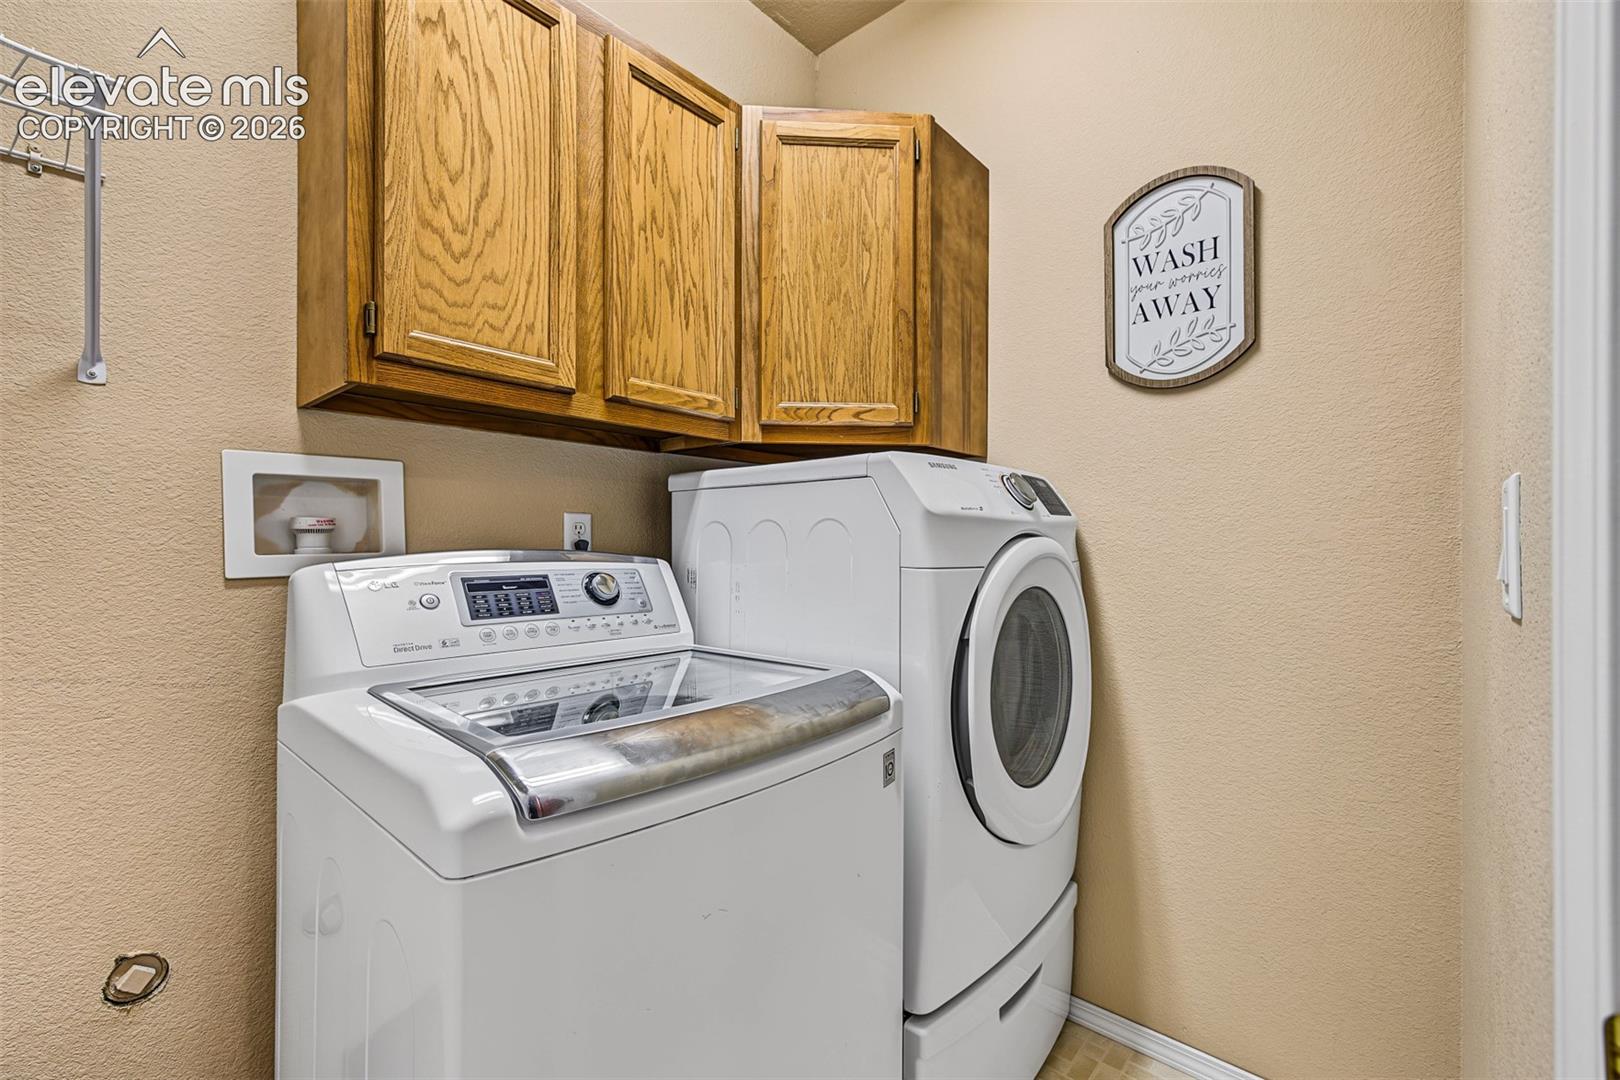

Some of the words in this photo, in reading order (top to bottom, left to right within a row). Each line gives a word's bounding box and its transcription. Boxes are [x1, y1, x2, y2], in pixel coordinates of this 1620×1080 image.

[1132, 236, 1220, 278] WASH
[1130, 280, 1165, 302] your
[1168, 263, 1227, 290] worries
[1132, 284, 1222, 326] AWAY
[927, 461, 957, 470] SAMSUNG
